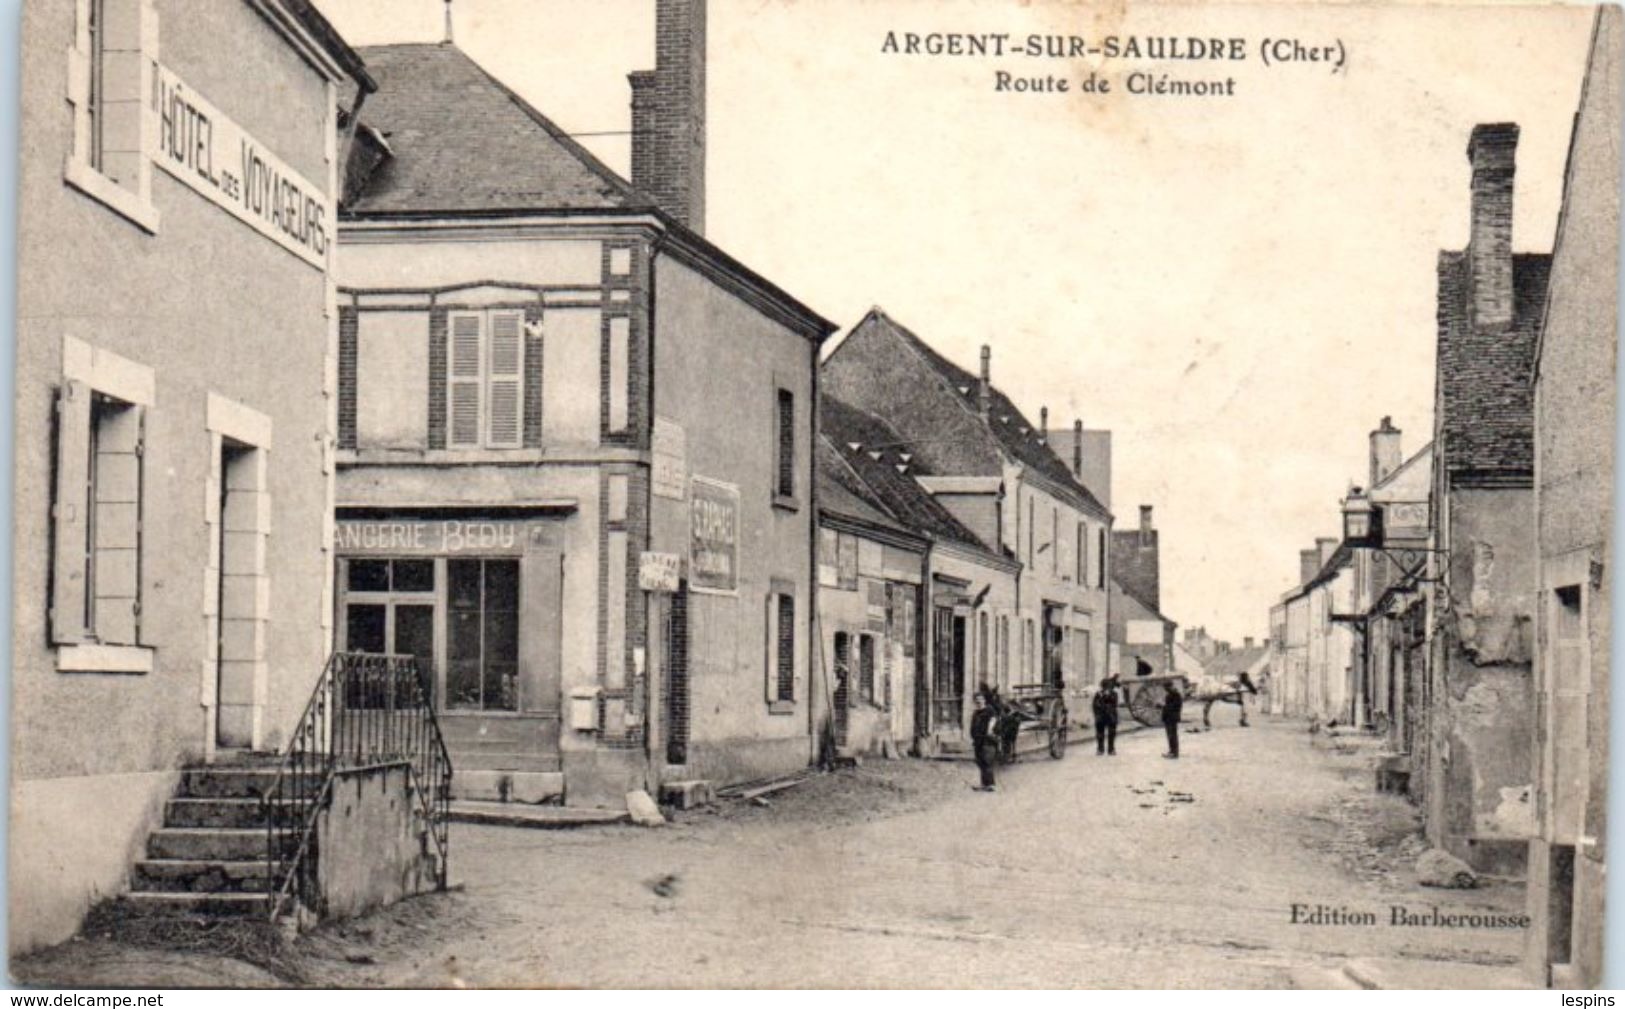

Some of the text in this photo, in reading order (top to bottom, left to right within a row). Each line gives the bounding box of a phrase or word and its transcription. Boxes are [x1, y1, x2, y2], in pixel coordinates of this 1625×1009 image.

[160, 79, 326, 257] HÔTEL DES VOYAGEURS
[440, 519, 515, 552] BEDU
